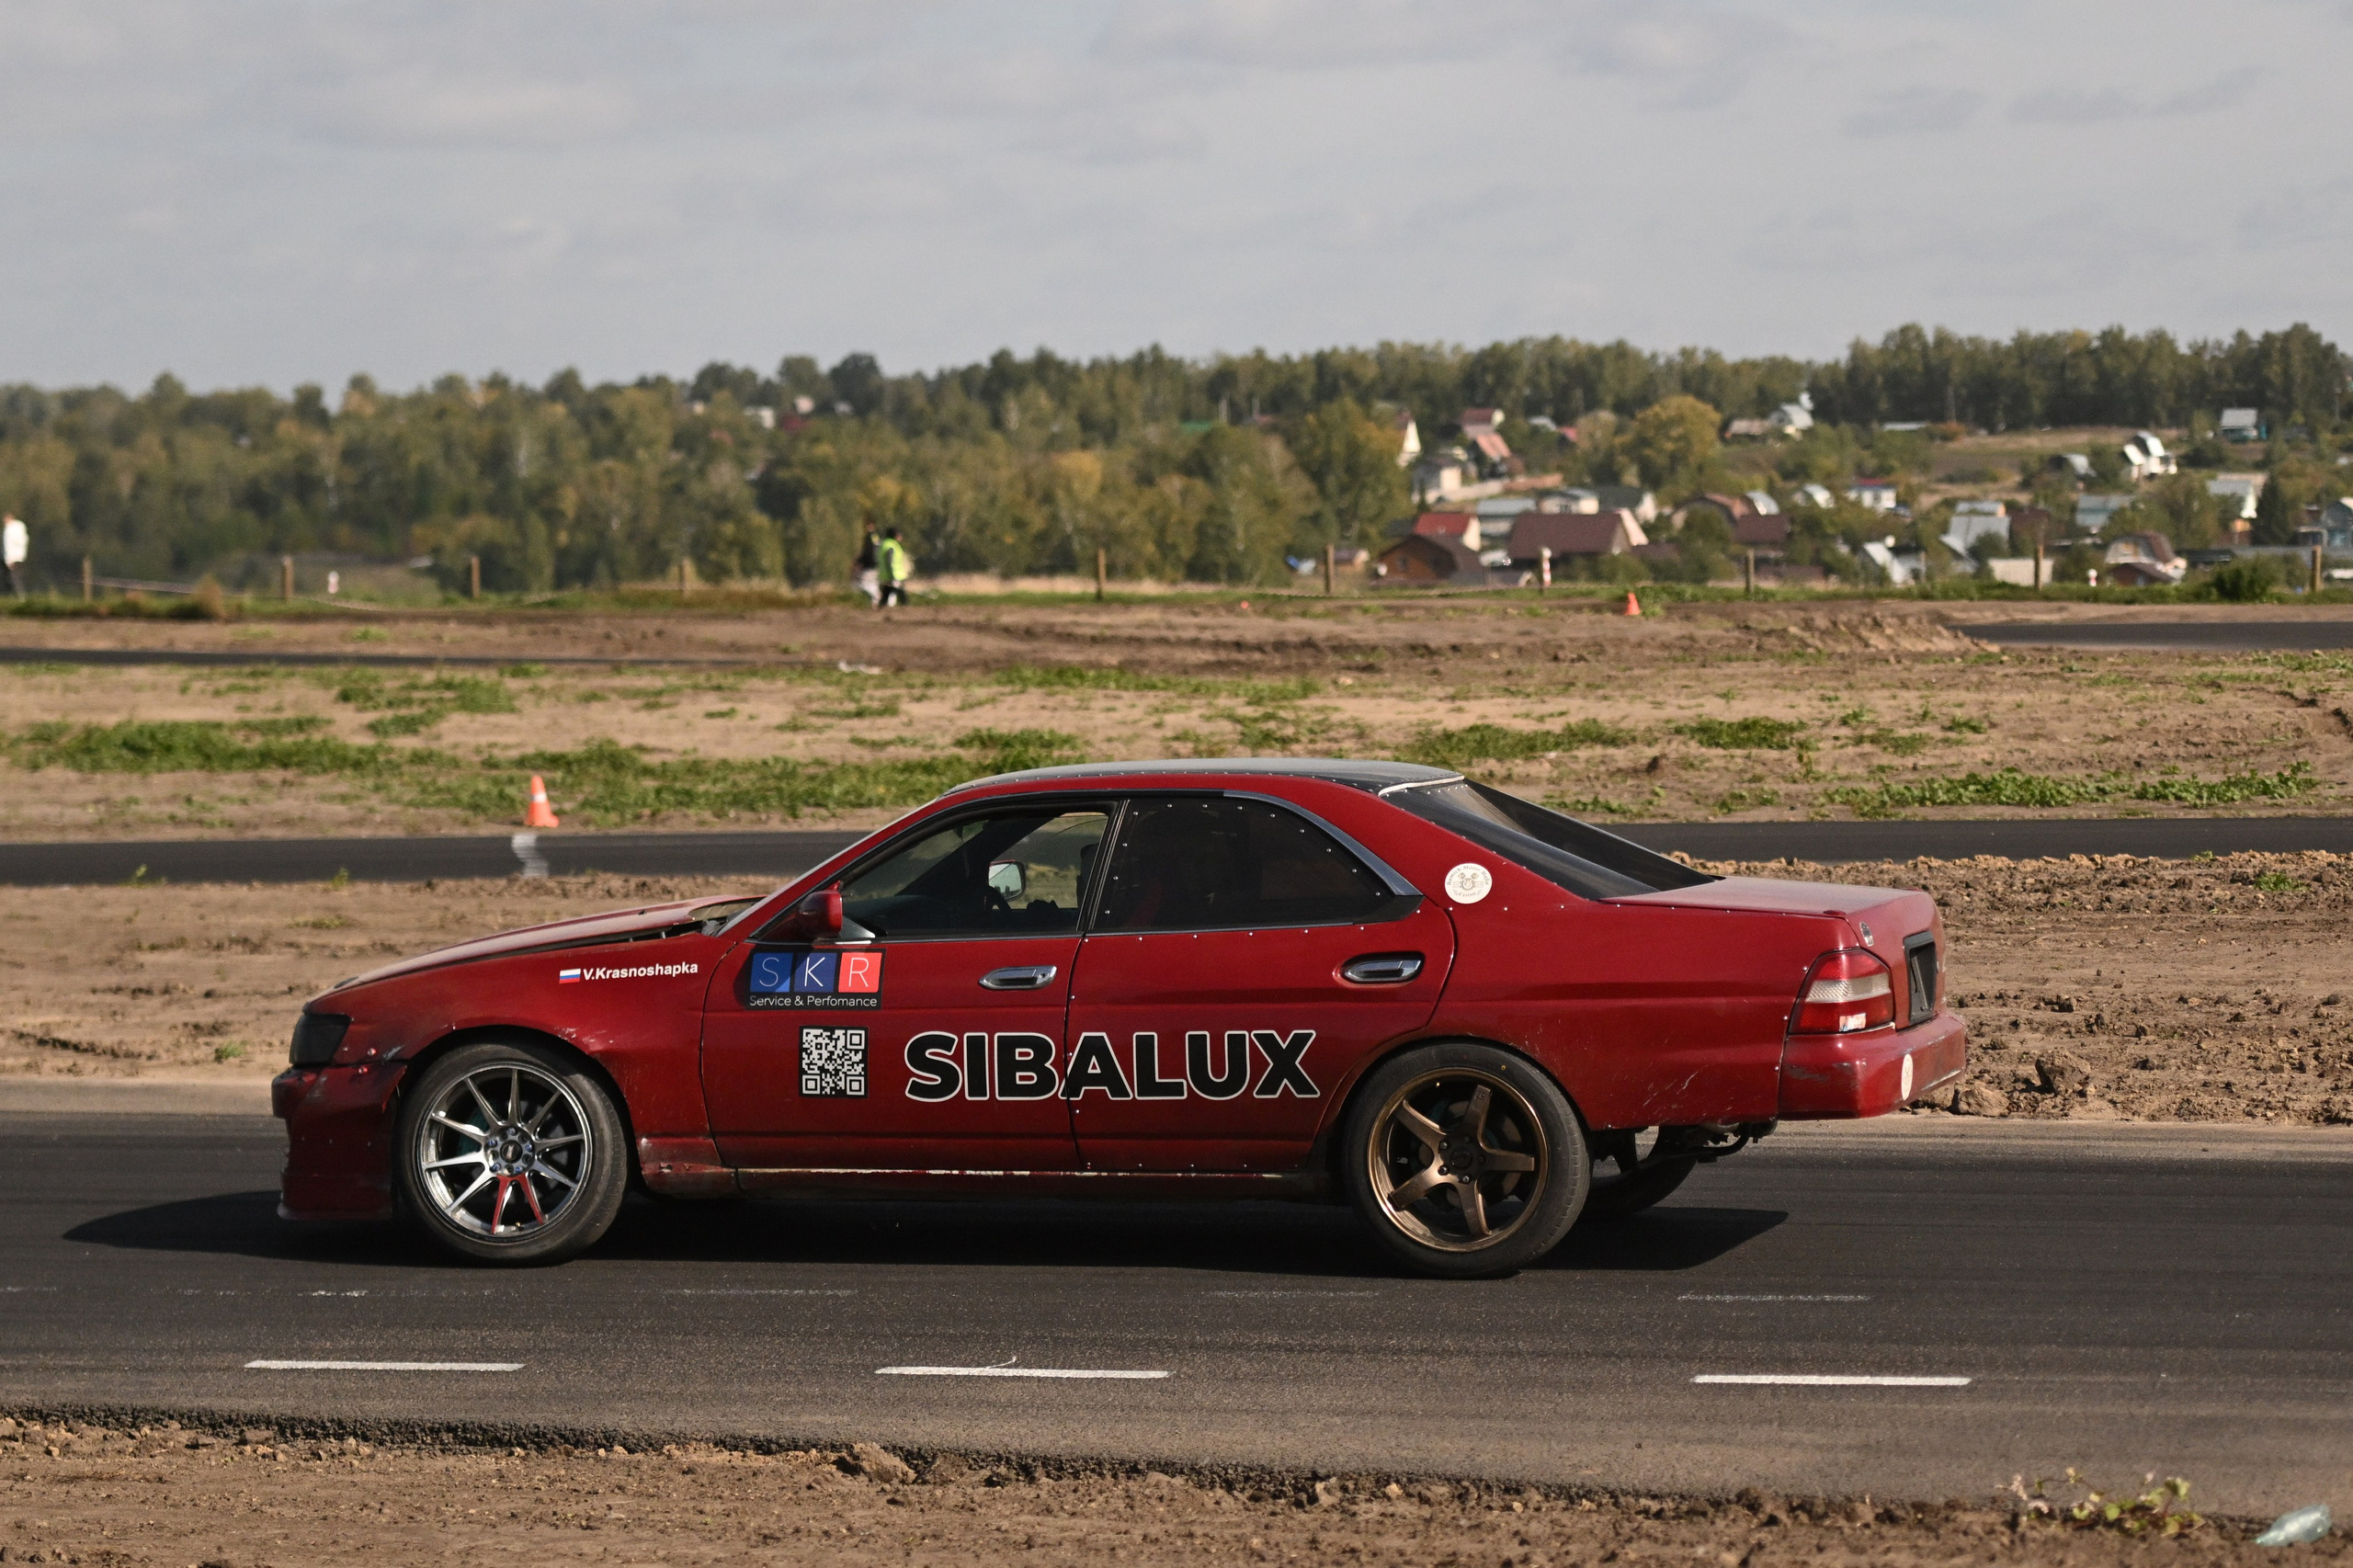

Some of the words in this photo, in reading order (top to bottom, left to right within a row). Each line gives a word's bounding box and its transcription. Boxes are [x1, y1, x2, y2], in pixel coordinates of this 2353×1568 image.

[583, 961, 699, 981] V.Krasnoshapka
[759, 957, 869, 987] SKR
[749, 996, 791, 1006] Service
[794, 996, 804, 1006] &
[807, 995, 878, 1007] Perfomance
[904, 1030, 1321, 1102] SIBALUX
